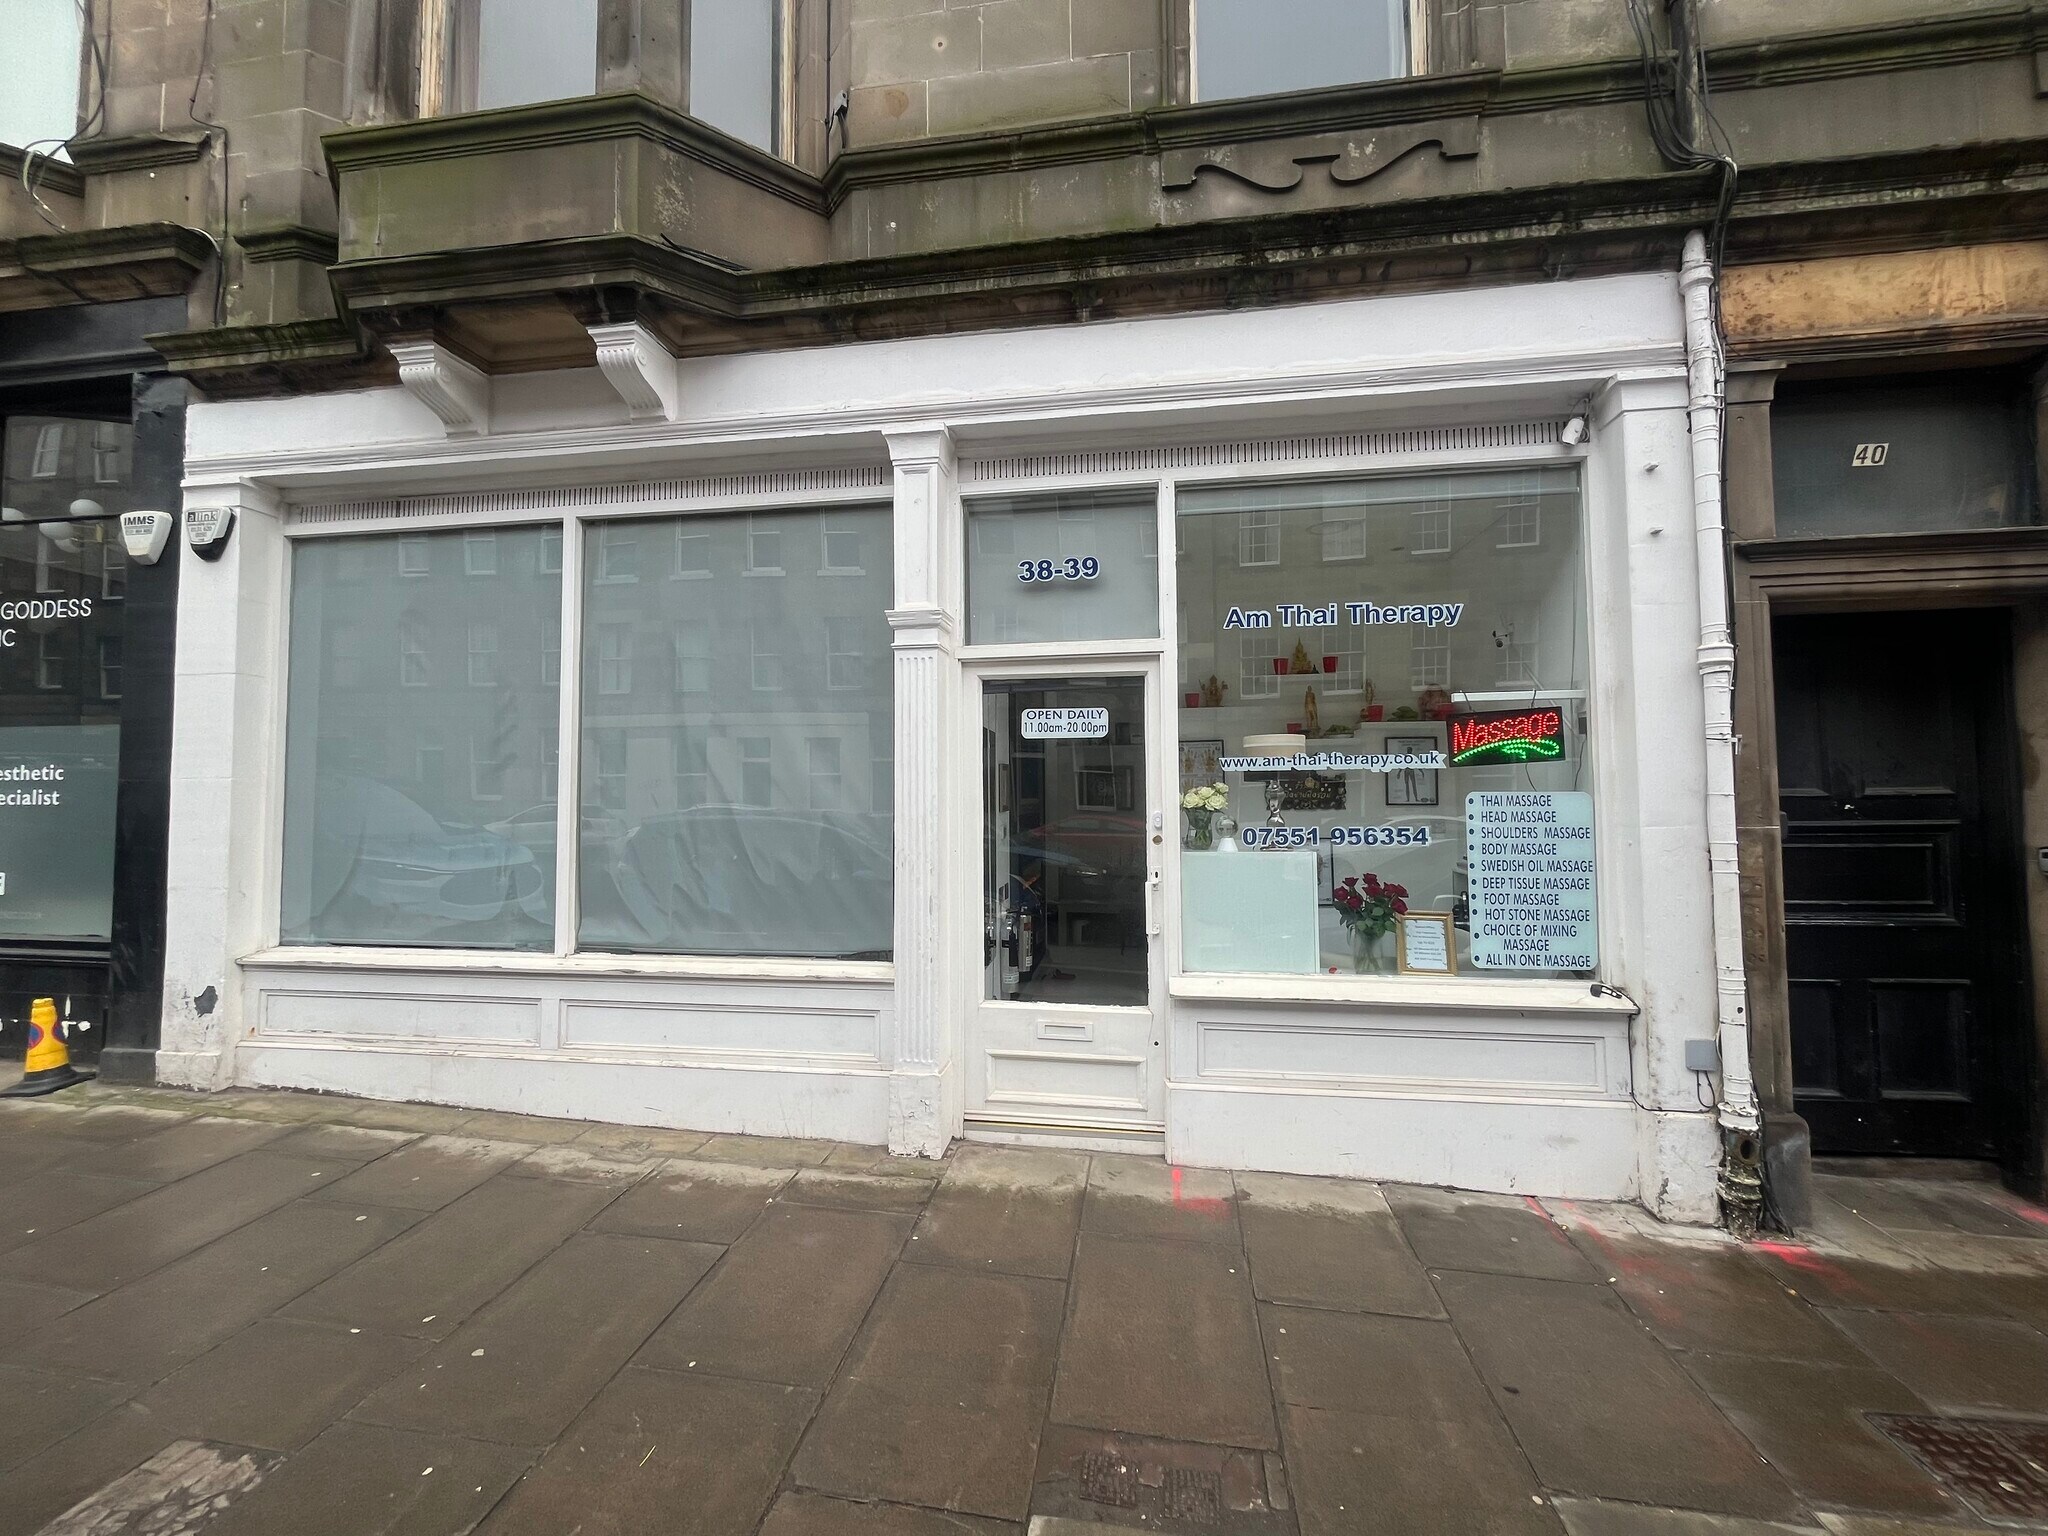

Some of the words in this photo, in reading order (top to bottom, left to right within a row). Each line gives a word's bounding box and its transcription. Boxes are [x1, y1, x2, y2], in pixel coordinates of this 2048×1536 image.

[1855, 444, 1886, 465] 40
[124, 515, 155, 526] IMMS
[1018, 556, 1099, 582] 38-39
[0, 598, 92, 620] GODDESS
[1224, 607, 1271, 629] Am
[1277, 603, 1337, 627] Thai
[1345, 602, 1464, 627] Therapy
[1027, 710, 1062, 720] OPEN
[1067, 710, 1104, 720] DAILY
[1024, 722, 1107, 735] 11.00am-20.00pm
[1453, 711, 1559, 754] Massage
[1220, 751, 1440, 769] www.am-thai-therapy.co.uk
[1481, 795, 1503, 807] THAI
[1506, 795, 1552, 807] MASSAGE
[1481, 811, 1508, 823] HEAD
[1511, 811, 1557, 823] MASSAGE
[1242, 827, 1319, 846] 07551
[1330, 827, 1430, 846] 956354
[1481, 827, 1538, 839] SHOULDERS
[1544, 827, 1591, 839] MASSAGE
[1482, 843, 1508, 855] BODY
[1511, 843, 1557, 855] MASSAGE
[1481, 860, 1525, 872] SWEDISH
[1527, 860, 1544, 872] OIL
[1546, 860, 1594, 873] MASSAGE
[1482, 877, 1506, 889] DEEP
[1508, 877, 1541, 890] TISSUE
[1543, 877, 1590, 890] MASSAGE
[1484, 893, 1511, 905] FOOT
[1513, 893, 1560, 906] MASSAGE
[1485, 908, 1506, 921] HOT
[1508, 908, 1541, 921] STONE
[1543, 909, 1590, 922] MASSAGE
[1483, 923, 1521, 936] CHOICE
[1524, 924, 1538, 937] OF
[1540, 924, 1577, 937] MIXING
[1503, 939, 1550, 952] MASSAGE
[1486, 953, 1502, 966] ALL
[1505, 954, 1516, 966] IN
[1519, 954, 1541, 967] ONE
[1543, 955, 1591, 968] MASSAGE
